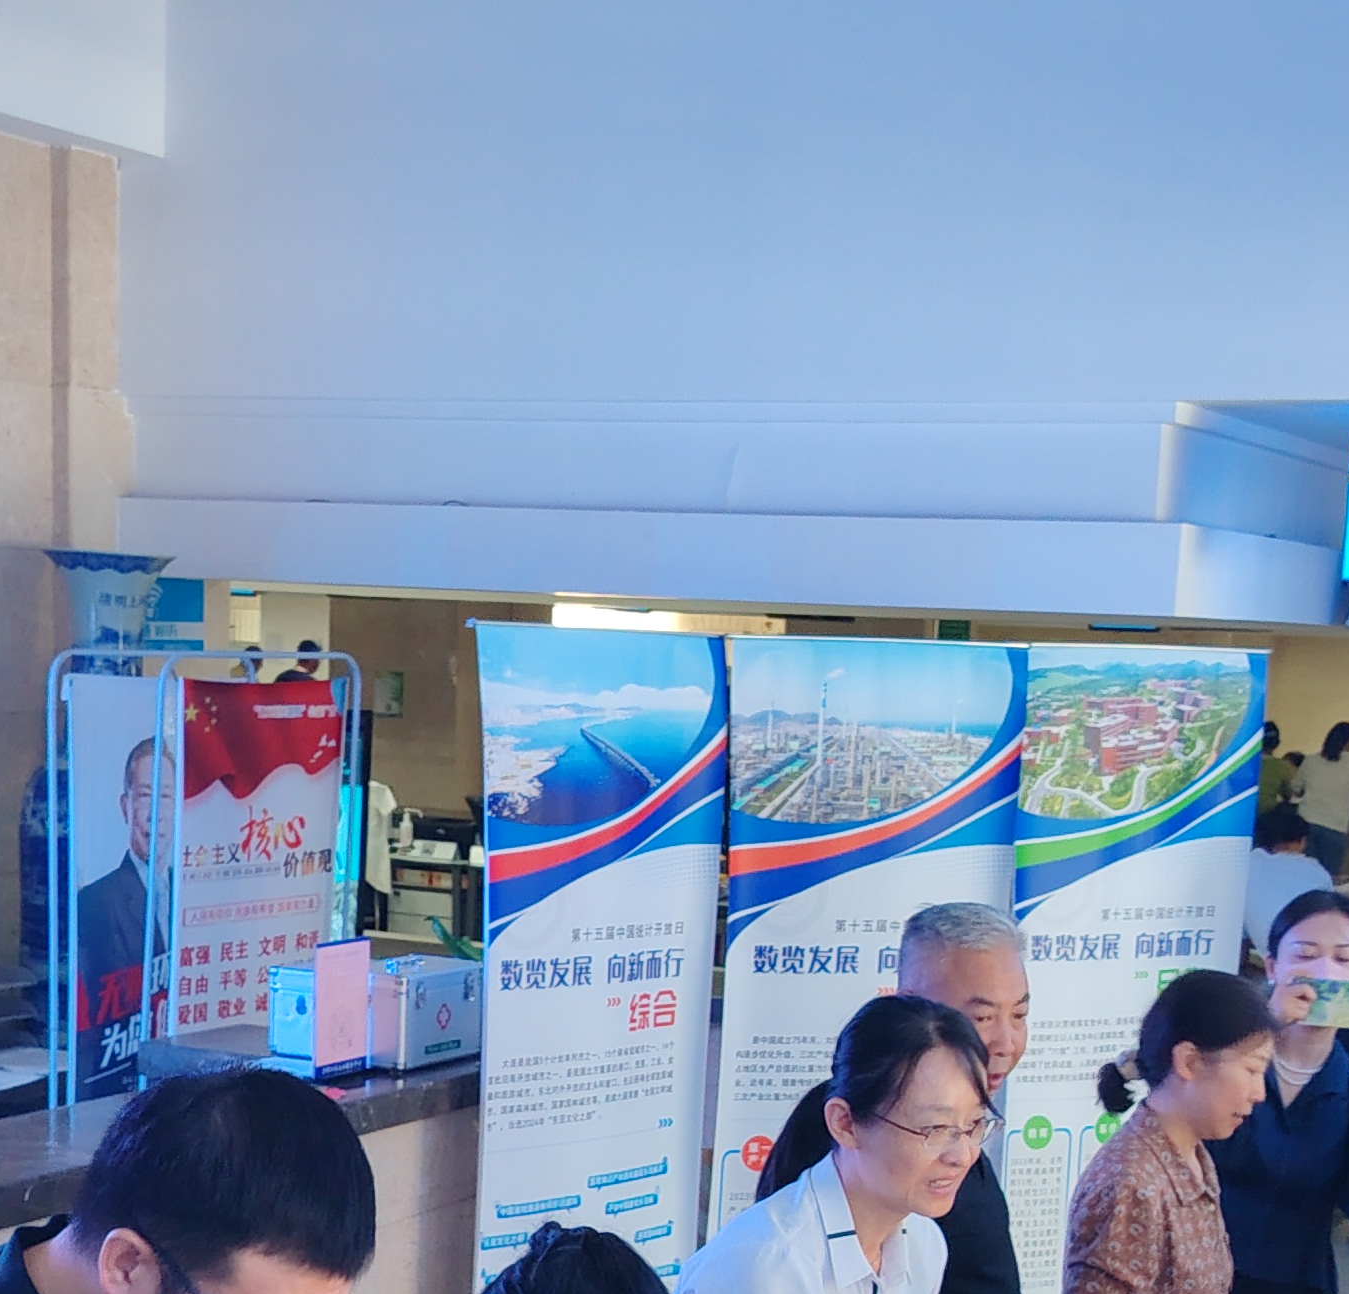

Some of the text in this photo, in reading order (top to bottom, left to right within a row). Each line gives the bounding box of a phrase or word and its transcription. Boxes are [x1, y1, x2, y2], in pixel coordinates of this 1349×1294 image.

[240, 805, 306, 863] 核心
[1102, 905, 1216, 921] 第十五届中国统计开放日
[571, 921, 685, 943] 第十五届中国统计开放日
[1030, 929, 1216, 962] 数览发展 向新而行
[179, 944, 211, 968] 富强
[219, 940, 249, 963] 民主
[258, 934, 287, 958] 文明
[752, 945, 860, 975] 数览发展
[178, 974, 209, 997] 自由
[218, 967, 248, 991] 平等
[500, 948, 685, 992] 数览发展 向新而行
[178, 1001, 208, 1026] 爱国
[217, 997, 247, 1020] 敬业
[628, 989, 677, 1032] 综合
